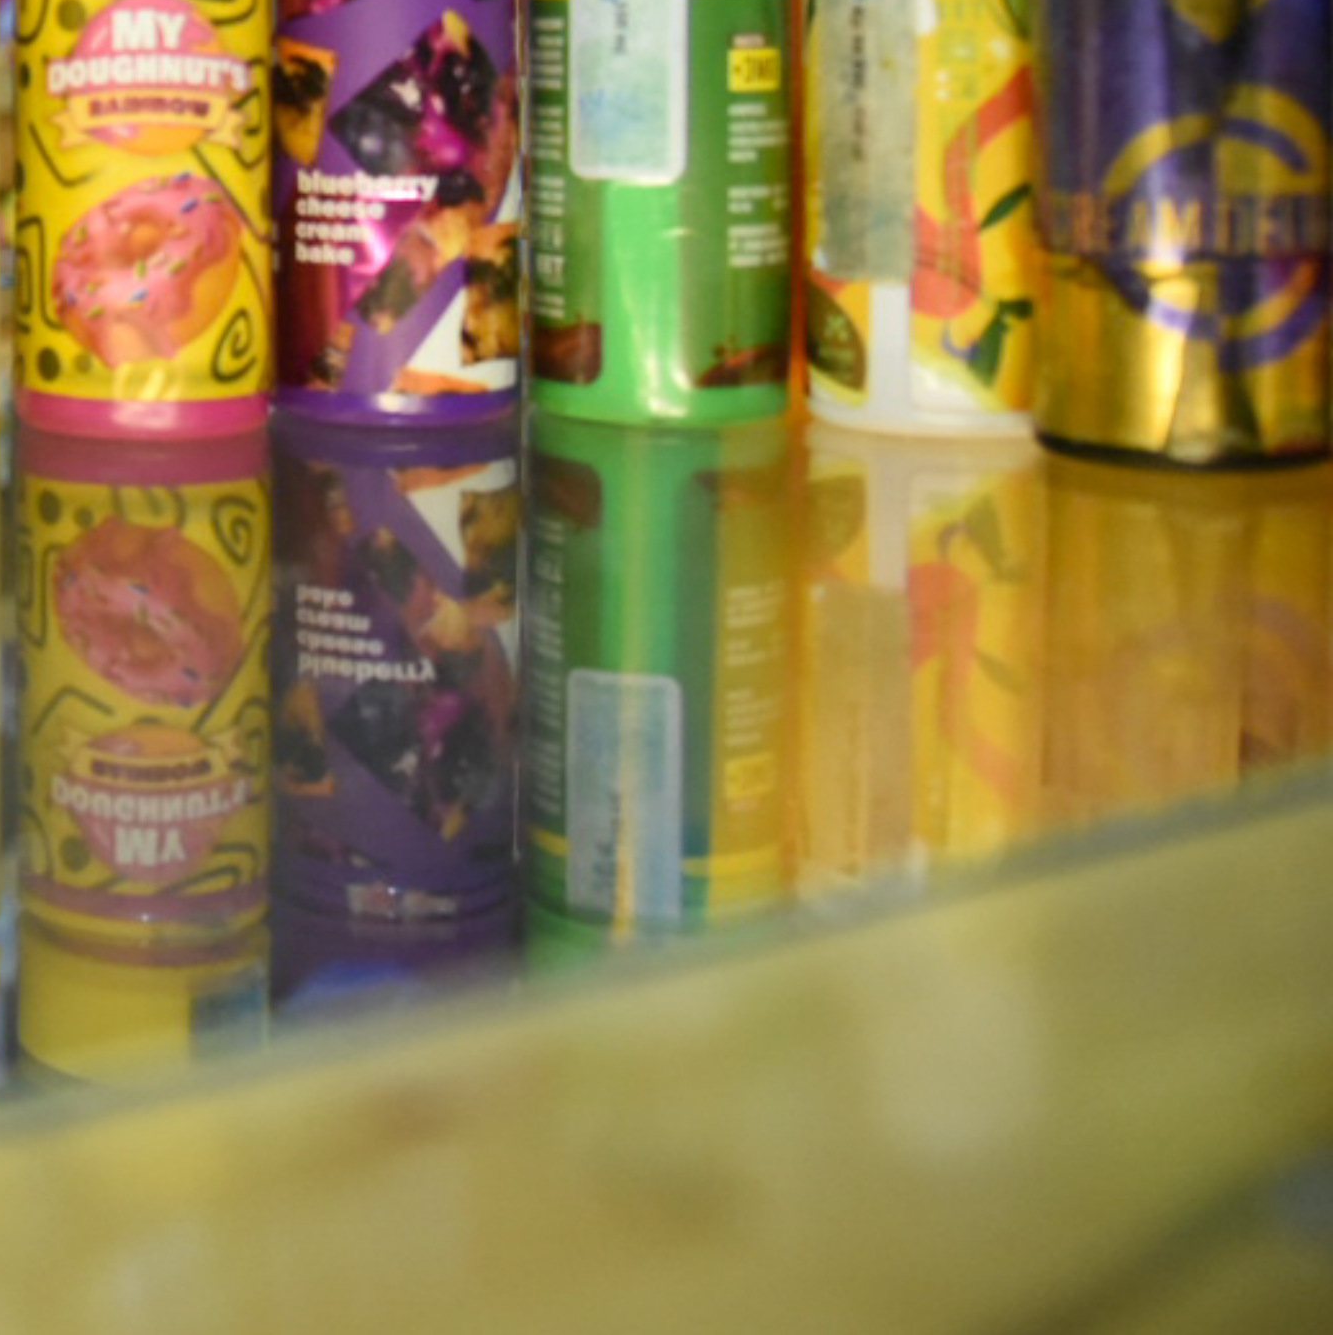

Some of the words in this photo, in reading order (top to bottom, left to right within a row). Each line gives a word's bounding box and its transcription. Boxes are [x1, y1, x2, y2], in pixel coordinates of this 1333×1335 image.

[111, 8, 187, 51] MY
[48, 53, 250, 95] DOUGHNUT'S
[296, 169, 439, 202] blueberry
[295, 196, 386, 221] cheese
[295, 220, 372, 243] cream
[295, 241, 356, 266] bake
